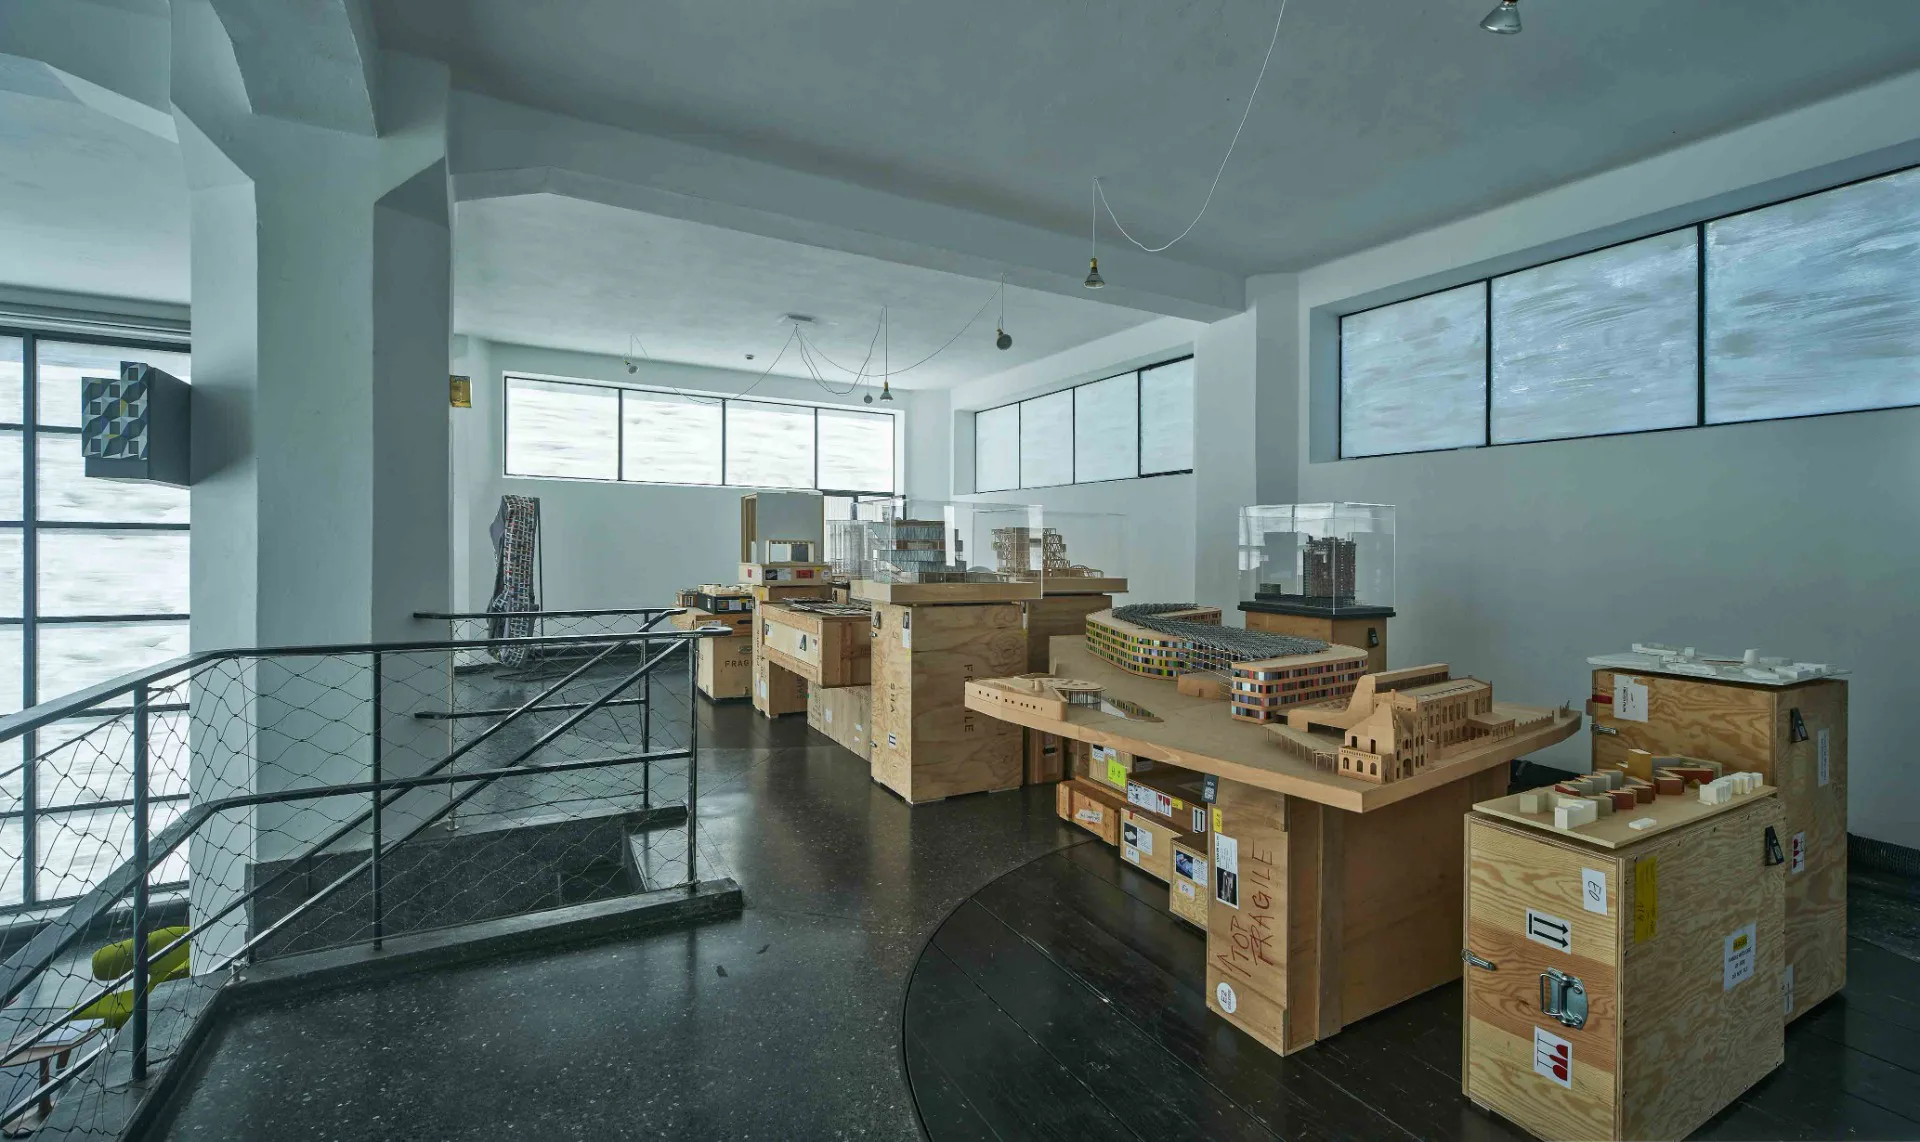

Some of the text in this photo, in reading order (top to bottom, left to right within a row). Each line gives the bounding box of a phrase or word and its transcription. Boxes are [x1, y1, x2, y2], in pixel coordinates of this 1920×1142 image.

[725, 660, 749, 668] FRAG
[964, 664, 974, 732] FRILE
[1250, 839, 1275, 967] FRAGILE
[1230, 915, 1250, 962] TOP
